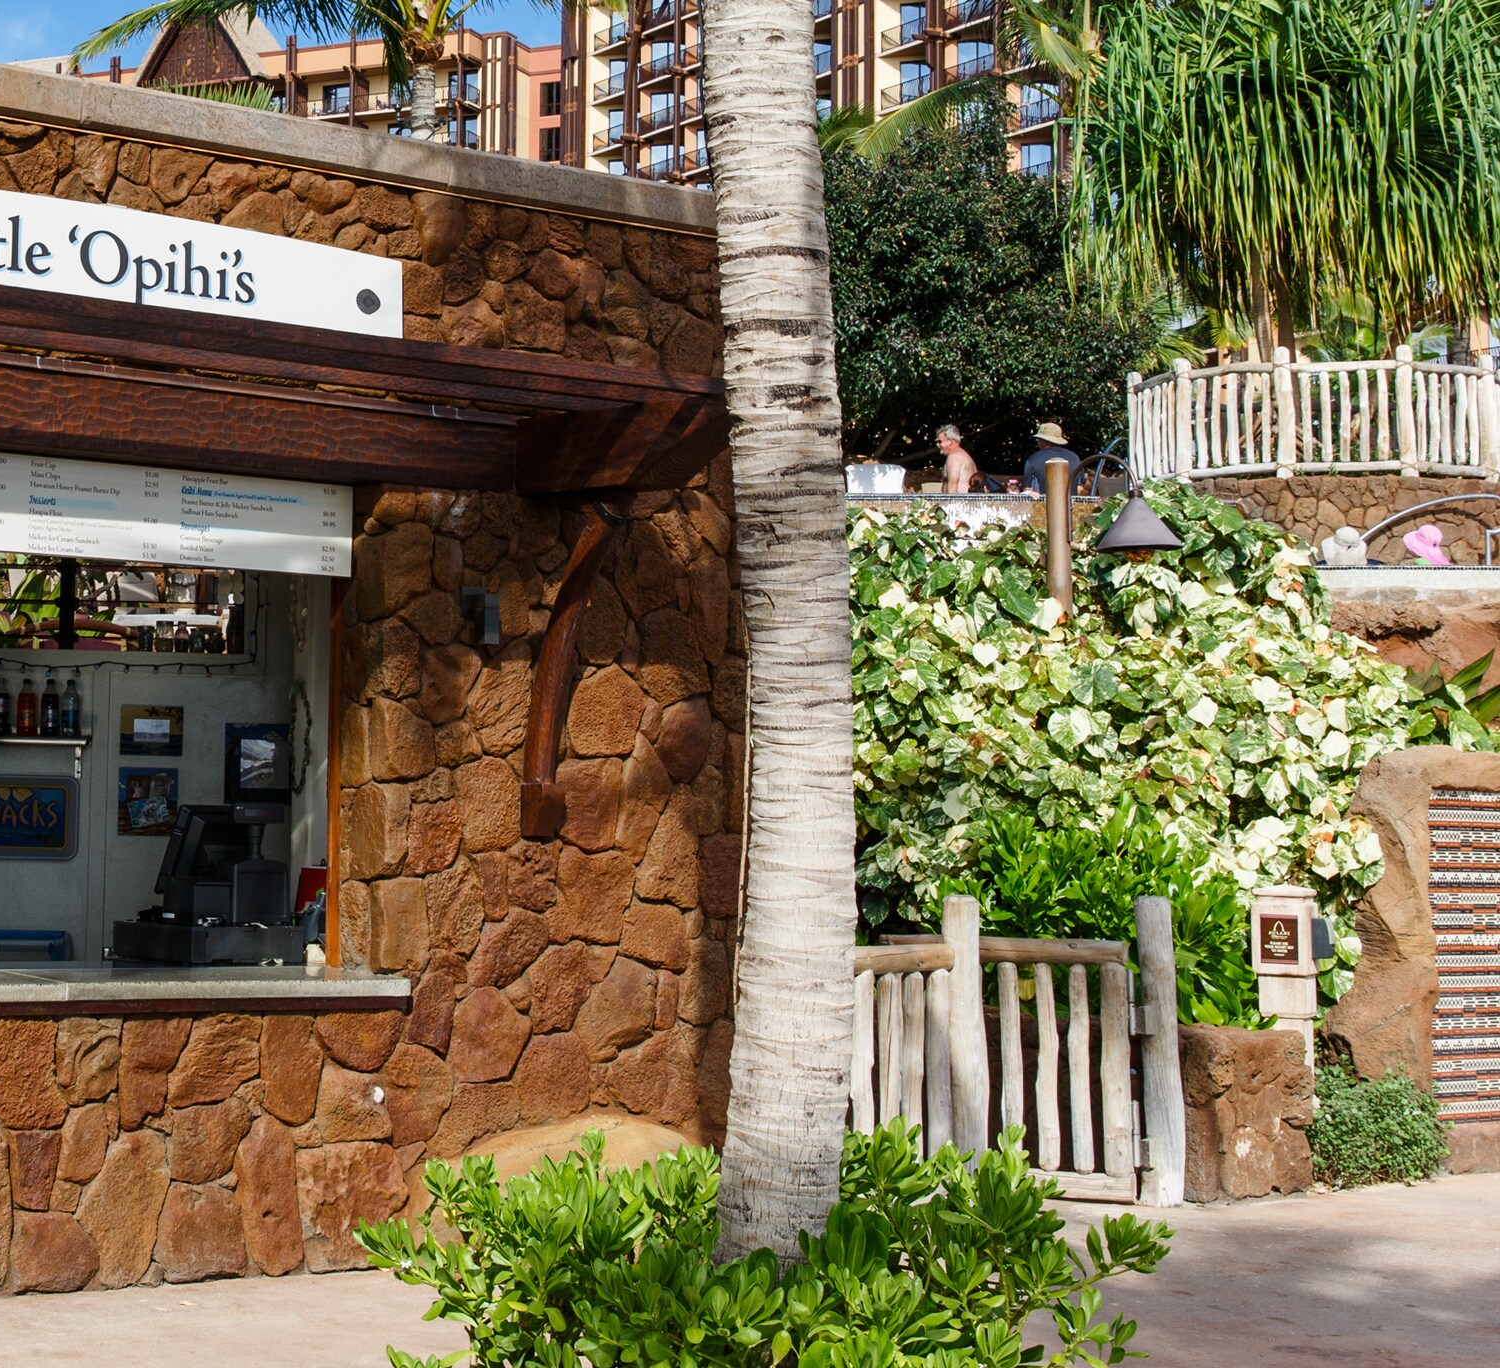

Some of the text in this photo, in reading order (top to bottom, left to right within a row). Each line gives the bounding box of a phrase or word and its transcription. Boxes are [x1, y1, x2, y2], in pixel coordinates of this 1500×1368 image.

[44, 461, 57, 471] Cup
[45, 472, 61, 481] Chips
[182, 475, 206, 485] Pineapple
[56, 483, 74, 492] Honey
[110, 488, 121, 496] Dip
[181, 485, 196, 495] Keiki
[196, 487, 213, 496] Menu
[29, 495, 57, 506] Desserts
[219, 501, 231, 510] Jelly
[232, 503, 250, 512] Mickey
[250, 504, 274, 512] Sandwich
[29, 508, 49, 517] Haupia
[180, 522, 211, 535] Beverages
[28, 533, 48, 543] Mickey
[28, 543, 48, 552] Mickey
